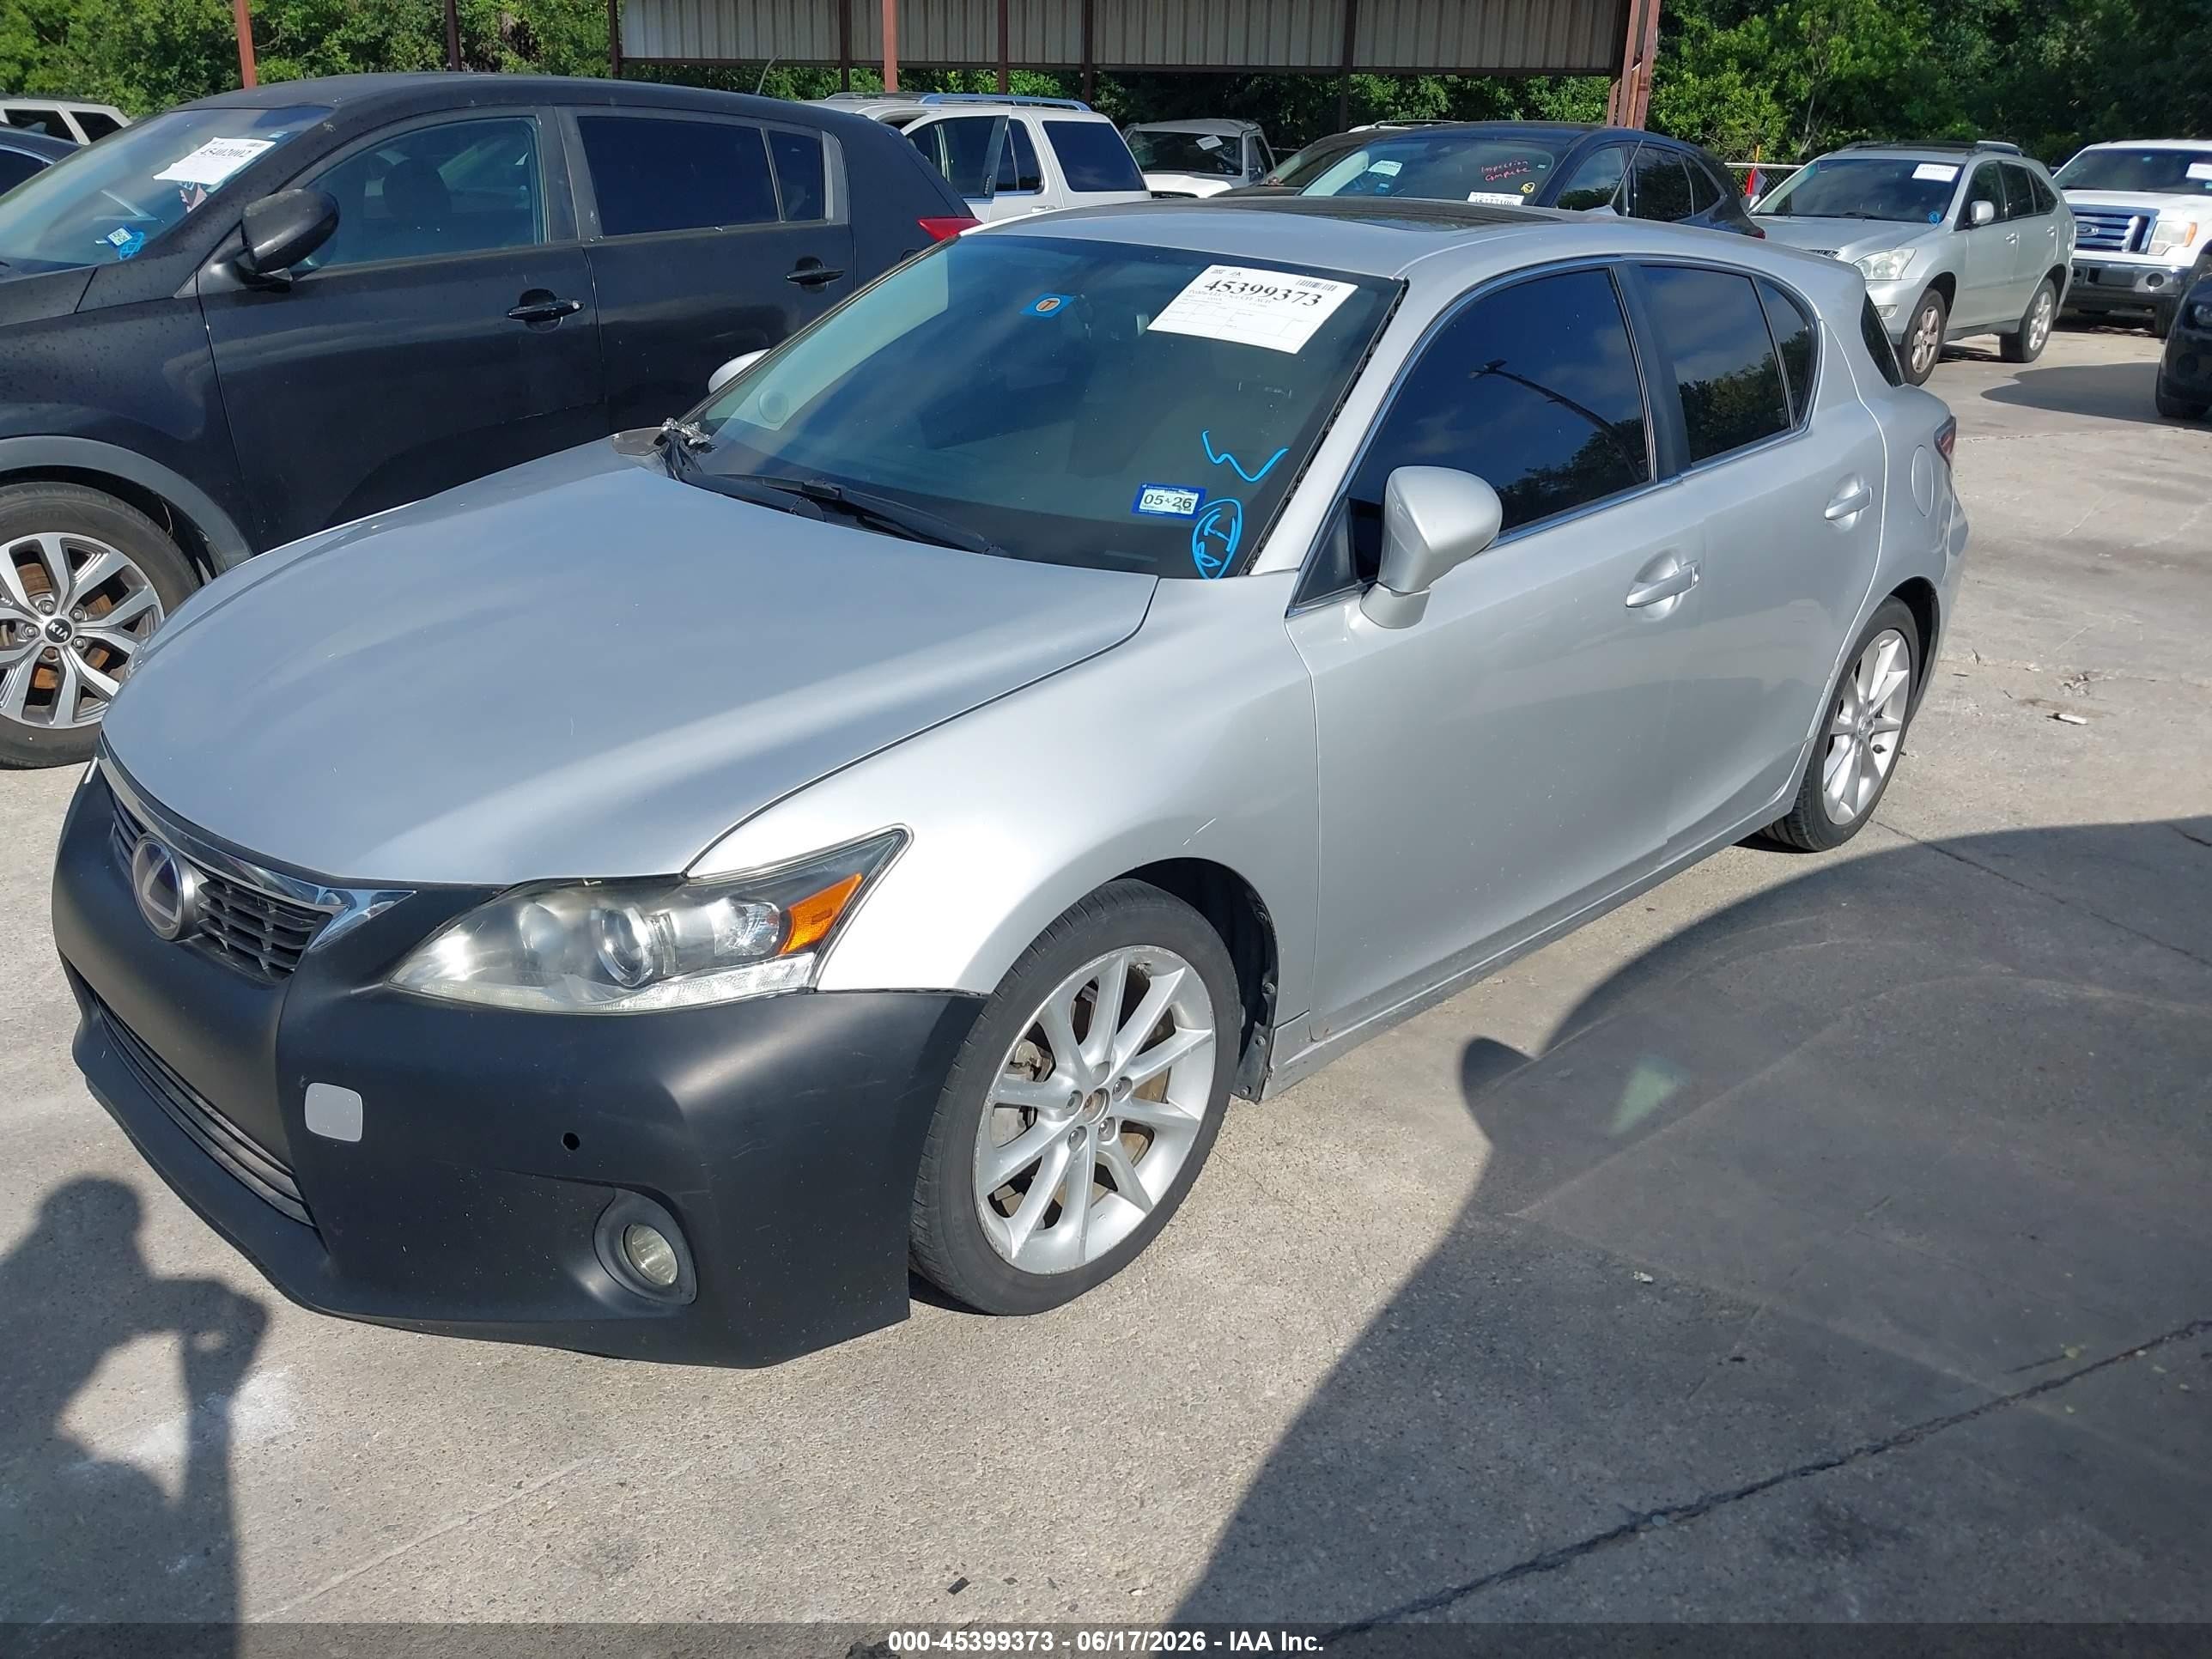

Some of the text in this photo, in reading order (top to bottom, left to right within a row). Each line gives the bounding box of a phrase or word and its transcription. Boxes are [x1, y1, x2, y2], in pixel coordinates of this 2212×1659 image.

[1204, 279, 1322, 307] 45399373
[1144, 494, 1164, 506] 05
[1171, 496, 1193, 508] 26
[48, 620, 68, 641] KIA
